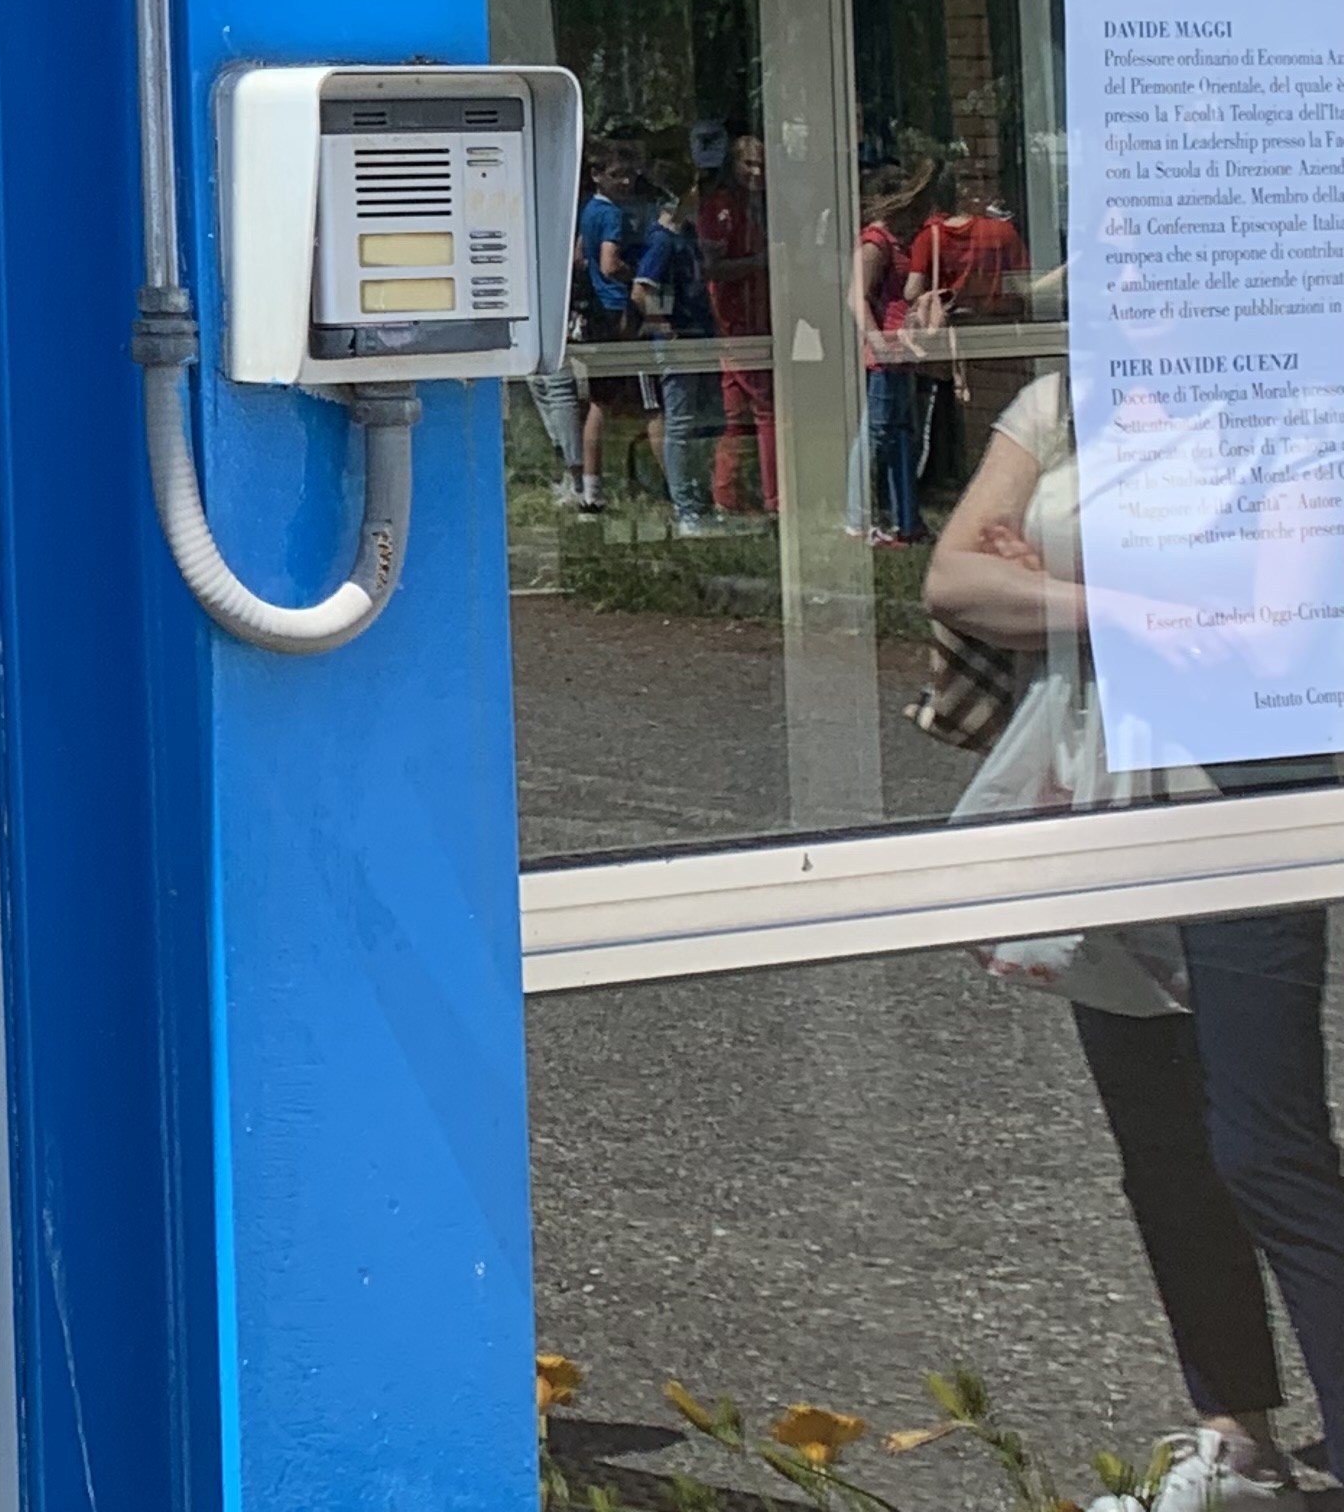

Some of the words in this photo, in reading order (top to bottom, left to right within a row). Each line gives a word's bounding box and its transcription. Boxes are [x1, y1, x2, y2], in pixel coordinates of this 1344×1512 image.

[1104, 21, 1170, 38] DAVIDE
[1176, 21, 1232, 38] MAGGI
[1104, 49, 1174, 67] Professore
[1177, 48, 1239, 66] ordinario
[1241, 48, 1254, 65] di
[1258, 48, 1322, 66] Economia
[1104, 77, 1125, 94] del
[1131, 77, 1195, 94] Piemonte
[1270, 76, 1290, 93] del
[1295, 76, 1333, 97] quale
[1105, 110, 1149, 127] presso
[1155, 105, 1167, 122] la
[1175, 105, 1224, 122] Facoltà
[1230, 104, 1293, 125] Teologica
[1105, 133, 1161, 156] diploma
[1165, 133, 1178, 150] in
[1183, 132, 1258, 154] Leadership
[1262, 136, 1305, 154] presso
[1309, 131, 1322, 148] la
[1106, 166, 1130, 180] con
[1137, 162, 1149, 178] la
[1156, 161, 1200, 178] Scuola
[1206, 160, 1218, 177] di
[1226, 159, 1292, 177] Direzione
[1106, 190, 1172, 207] economia
[1251, 187, 1308, 204] Membro
[1106, 218, 1140, 236] della
[1147, 217, 1225, 235] Conferenza
[1231, 214, 1307, 237] Episcopale
[1106, 251, 1162, 268] europea
[1166, 245, 1192, 263] che
[1196, 245, 1207, 261] si
[1212, 249, 1267, 266] propone
[1270, 242, 1284, 260] di
[1107, 280, 1115, 292] e
[1121, 274, 1200, 292] ambientale
[1205, 271, 1239, 289] delle
[1245, 270, 1297, 288] aziende
[1109, 303, 1156, 321] Autore
[1160, 301, 1173, 319] di
[1179, 300, 1229, 318] diverse
[1234, 298, 1324, 321] pubblicazioni
[1329, 297, 1342, 314] in
[1110, 359, 1154, 377] PIER
[1160, 356, 1227, 376] DAVIDE
[1233, 353, 1299, 373] GUENZI
[1112, 388, 1169, 406] Docente
[1173, 385, 1187, 403] di
[1191, 384, 1248, 405] Teologia
[1252, 381, 1299, 399] Morale
[1261, 438, 1275, 455] di
[1146, 614, 1192, 630] Essere
[1254, 691, 1302, 709] Istituto
